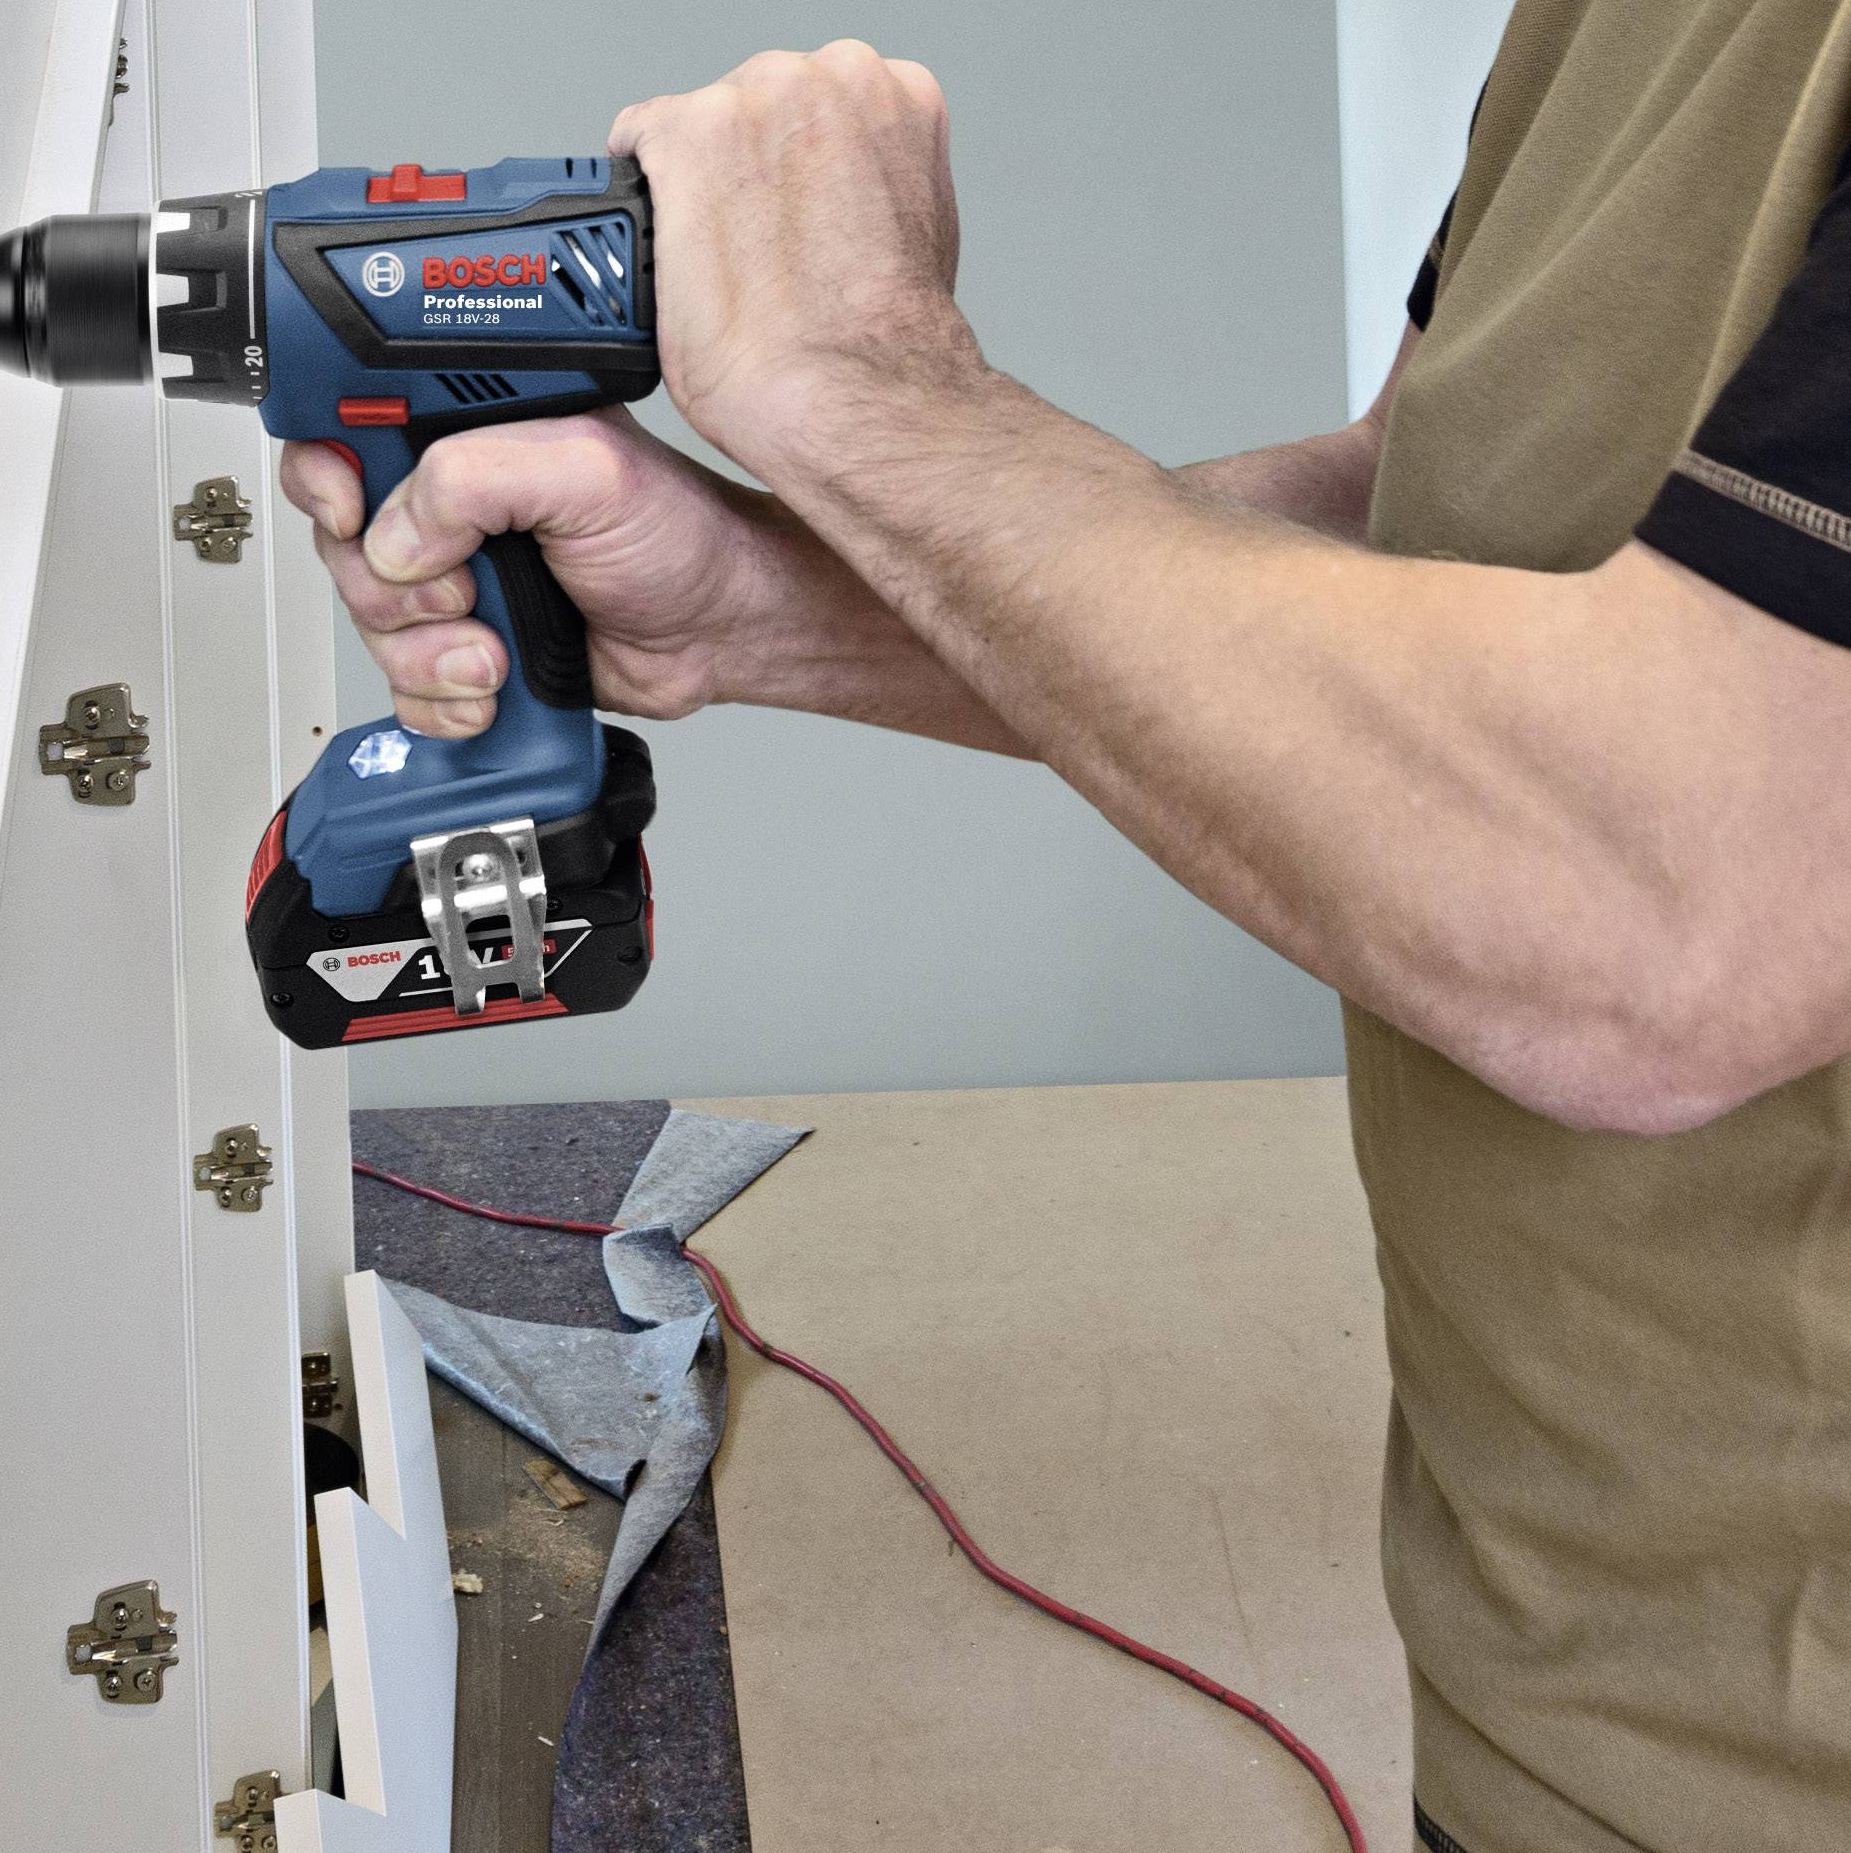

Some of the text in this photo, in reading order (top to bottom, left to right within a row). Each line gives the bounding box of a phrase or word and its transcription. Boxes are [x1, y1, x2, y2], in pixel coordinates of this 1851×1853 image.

[422, 254, 546, 288] BOSCH
[423, 294, 543, 309] Professional
[423, 313, 500, 324] GSR 18V-28
[244, 345, 264, 367] 20
[347, 950, 401, 968] BOSCH
